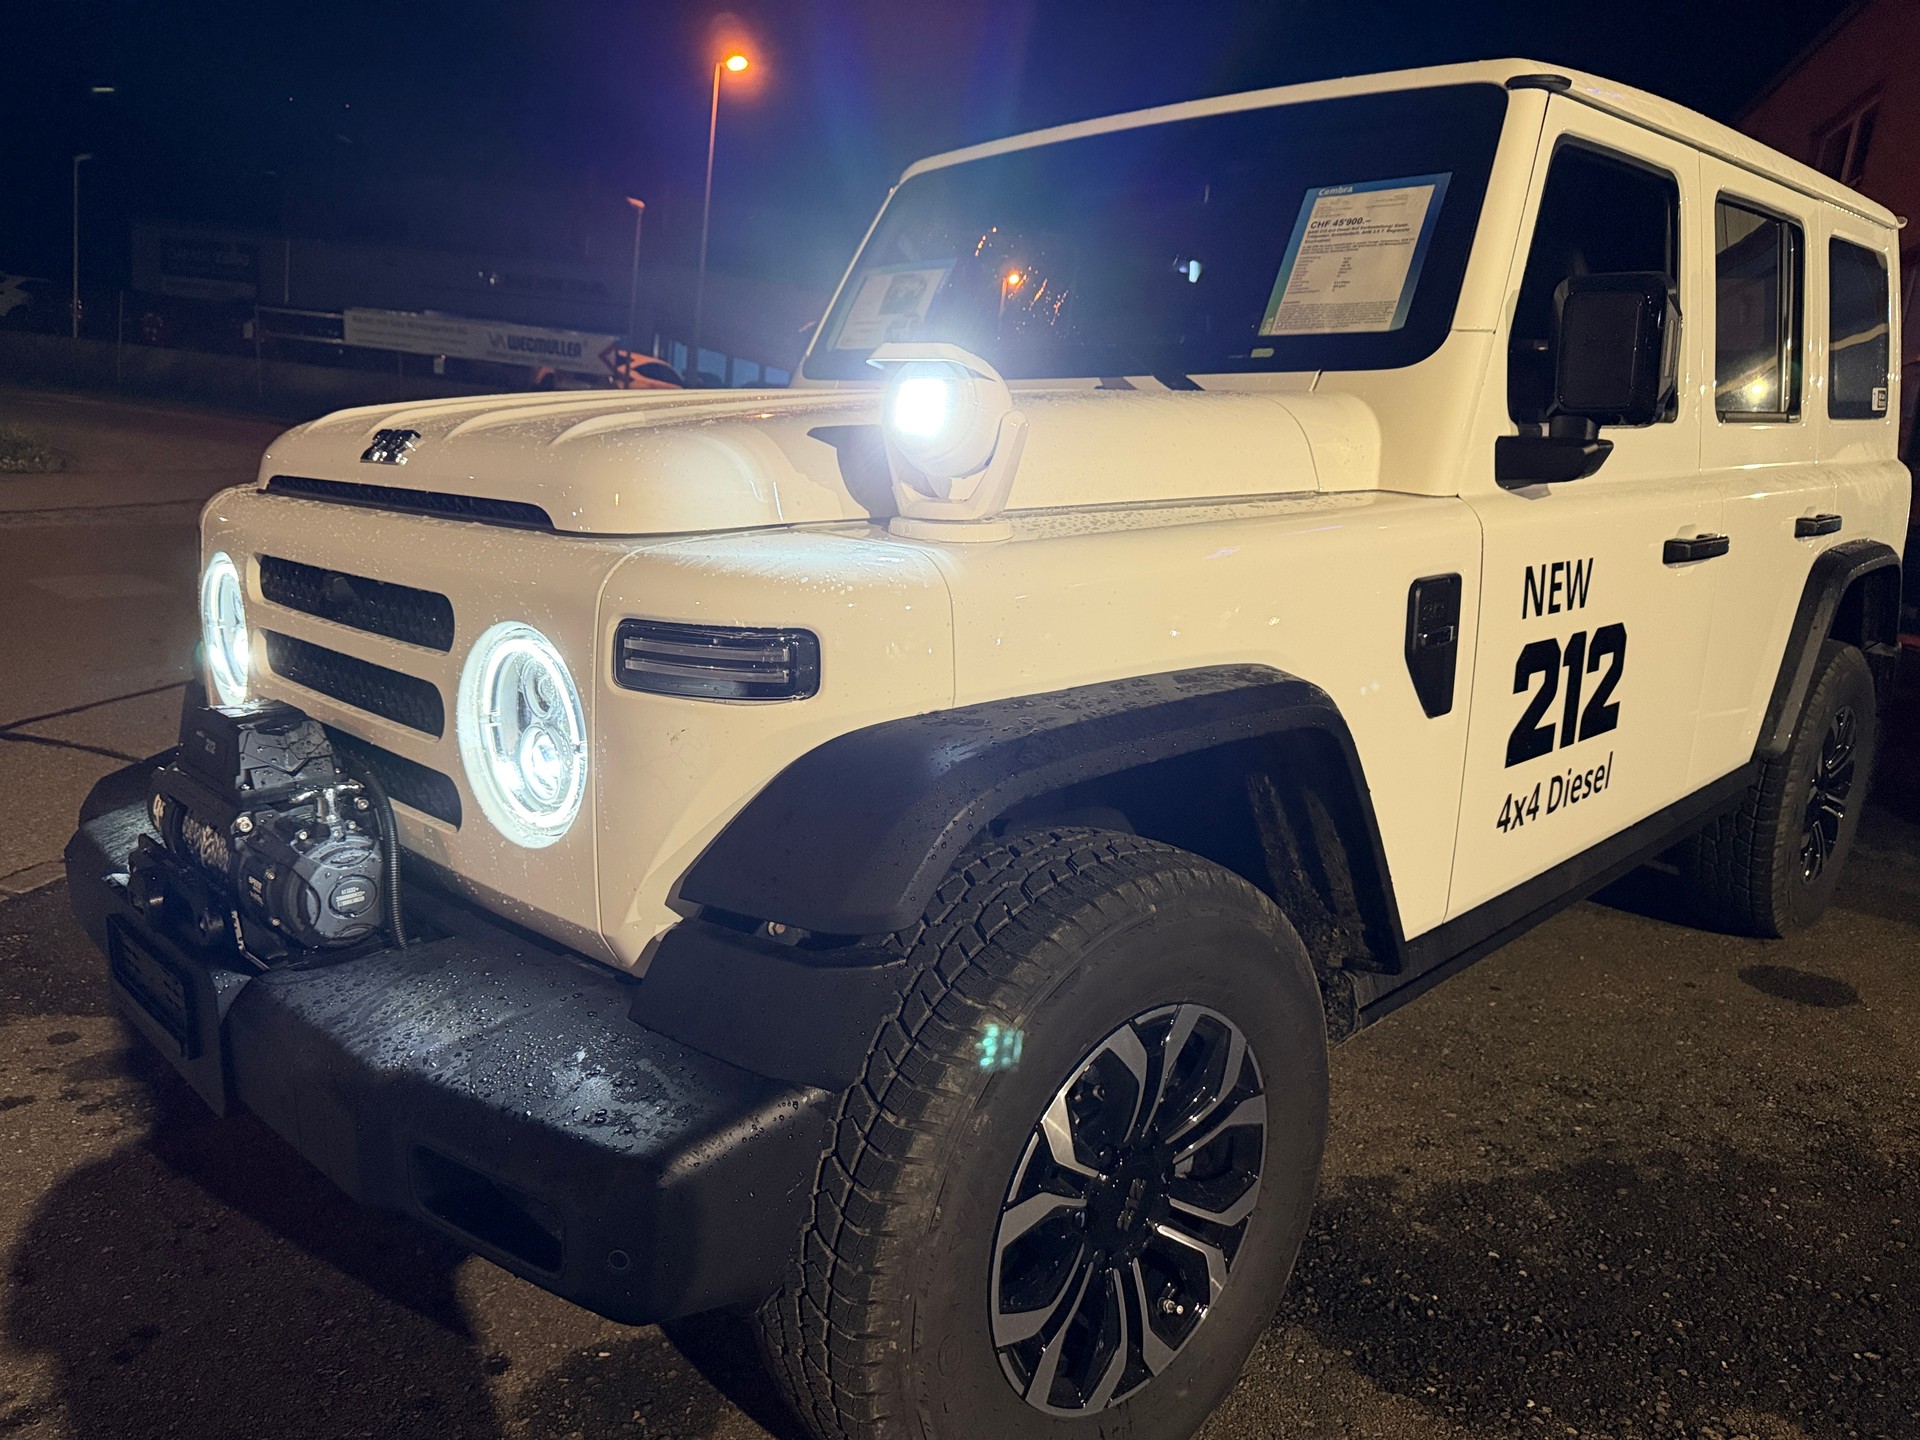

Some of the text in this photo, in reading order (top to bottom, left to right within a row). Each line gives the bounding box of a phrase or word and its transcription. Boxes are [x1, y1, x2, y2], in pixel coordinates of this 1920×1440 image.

[1319, 186, 1353, 196] Cembra
[1310, 220, 1330, 229] CHF
[1522, 557, 1594, 619] NEW
[1504, 622, 1627, 769] 212
[1496, 751, 1613, 833] 4x4 Diesel
